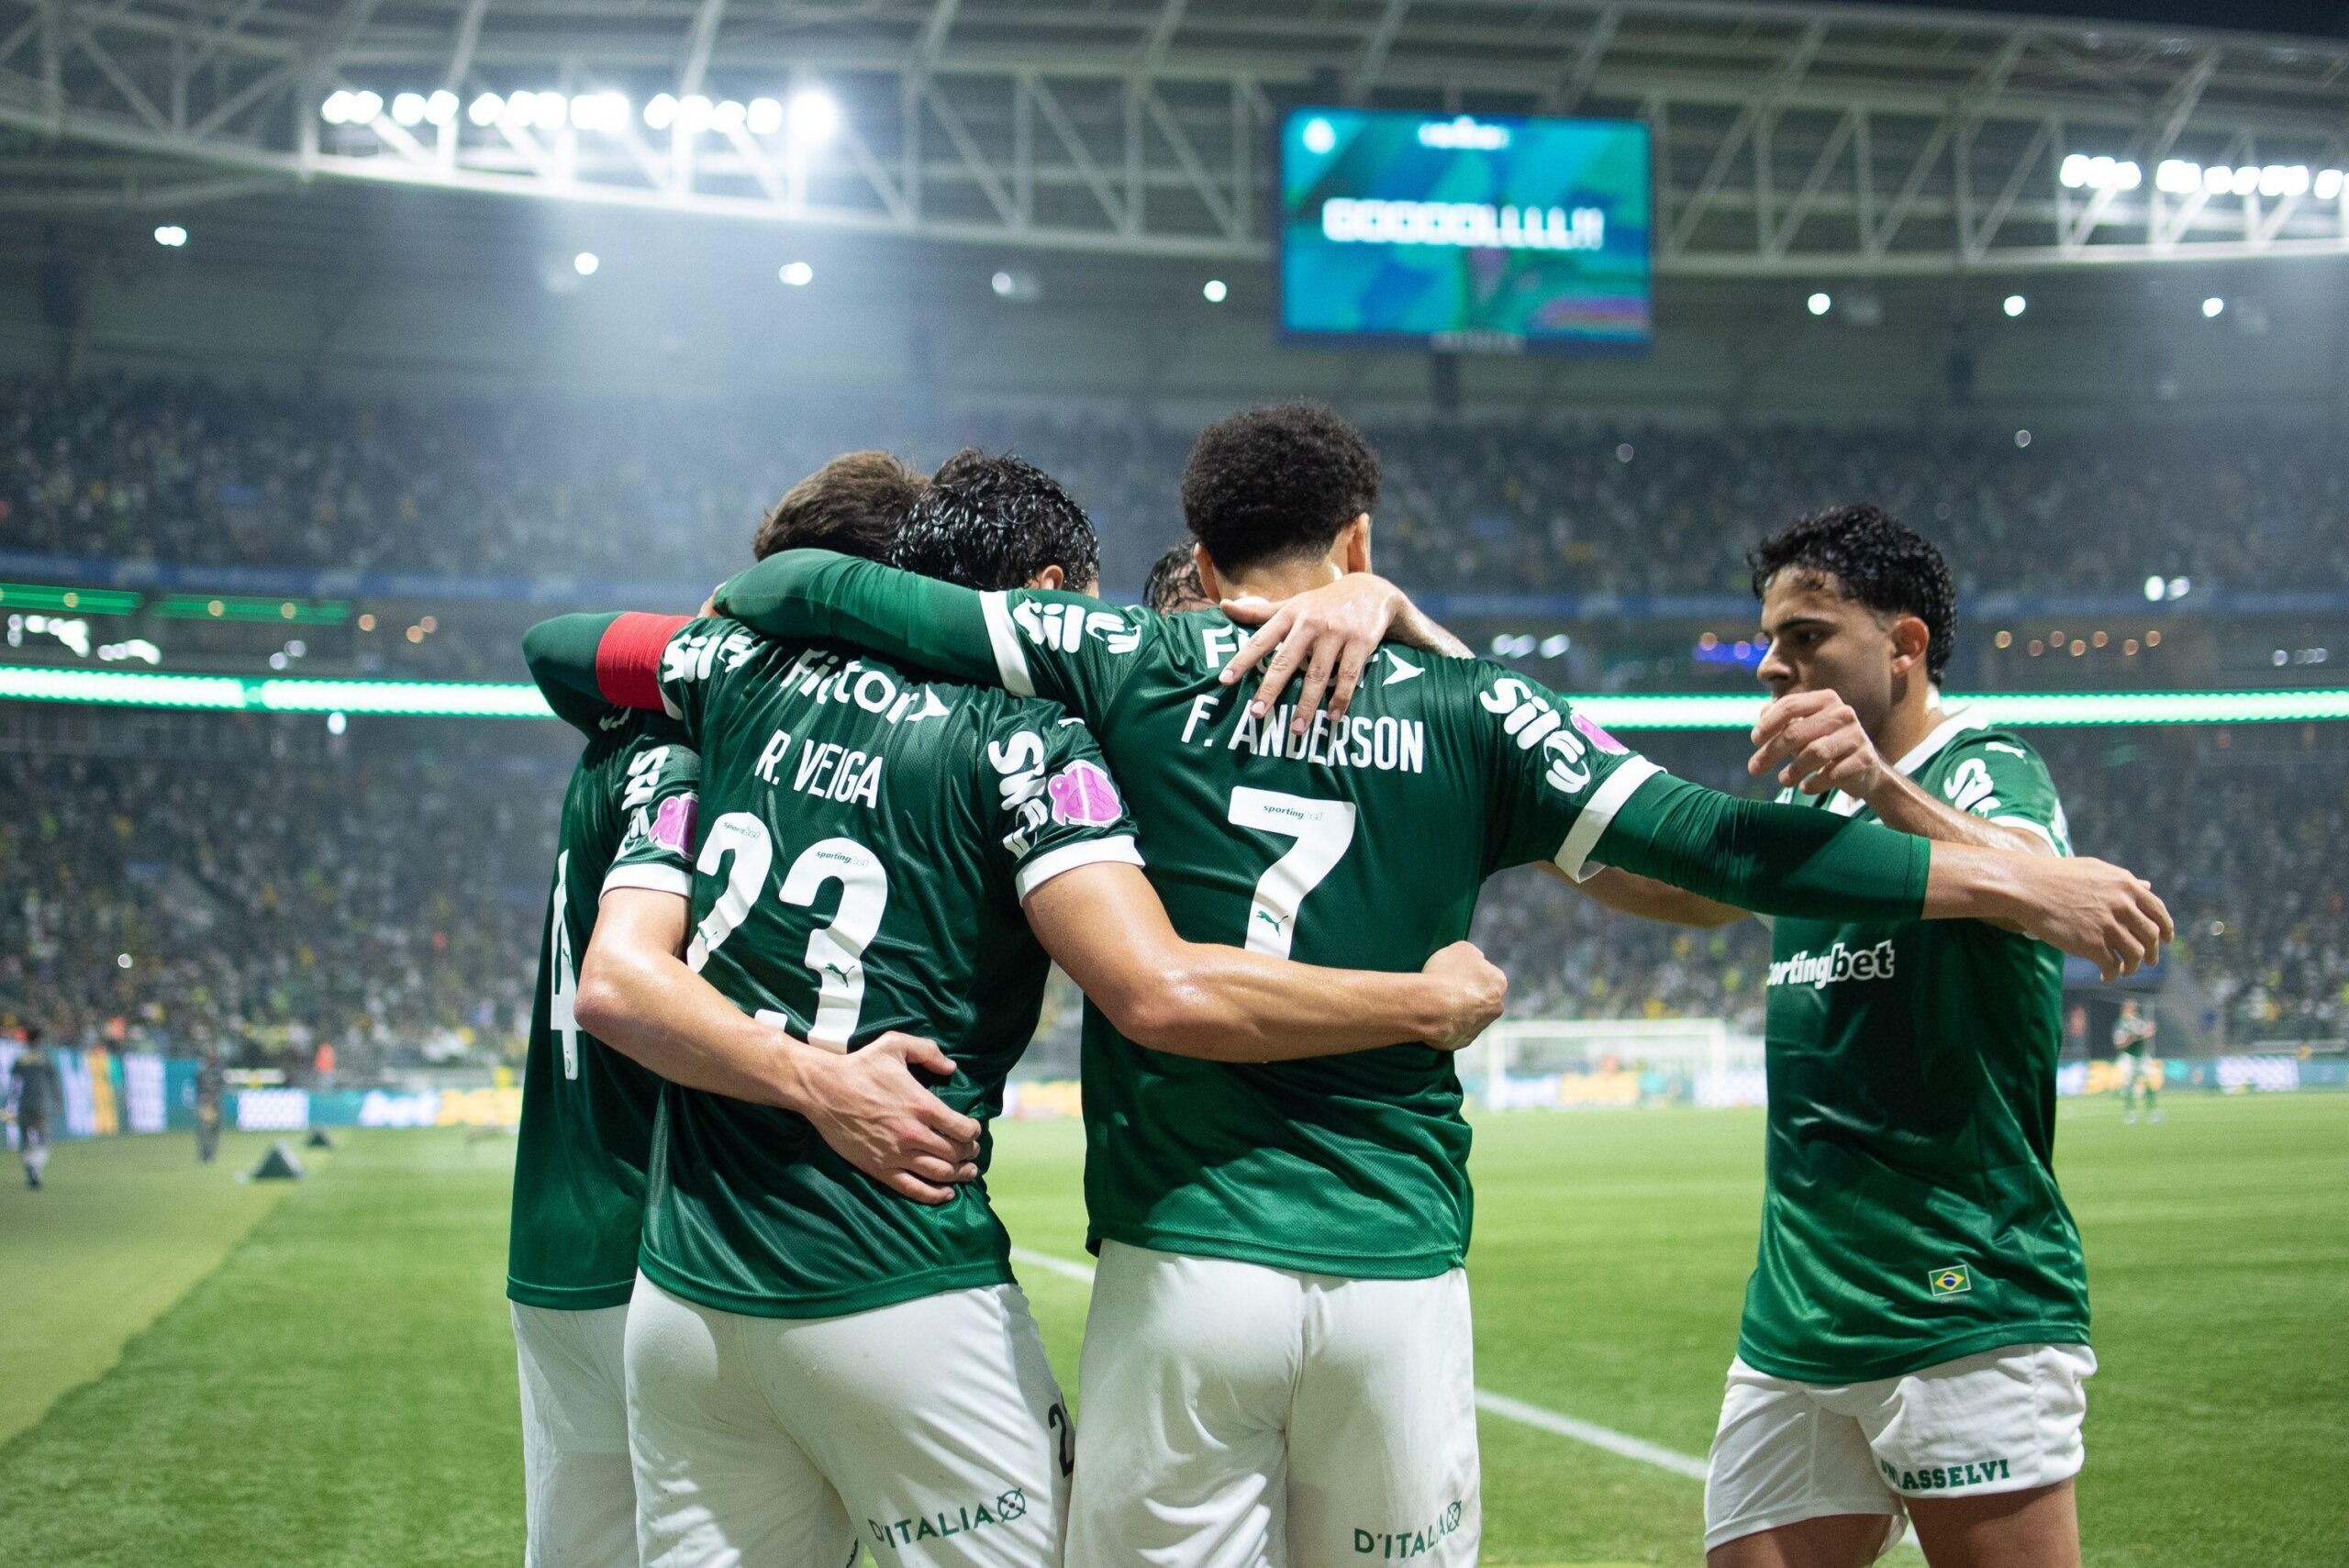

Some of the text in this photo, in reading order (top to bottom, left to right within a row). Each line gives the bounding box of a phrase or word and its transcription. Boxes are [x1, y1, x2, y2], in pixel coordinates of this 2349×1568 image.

[754, 728, 884, 809] R. VEIGA
[1181, 694, 1424, 773] F. ANDERSON
[1228, 785, 1357, 960] 7
[687, 812, 888, 1054] 23
[1767, 939, 1896, 990] ortingbet
[1354, 1514, 1446, 1559] D'ITALIA
